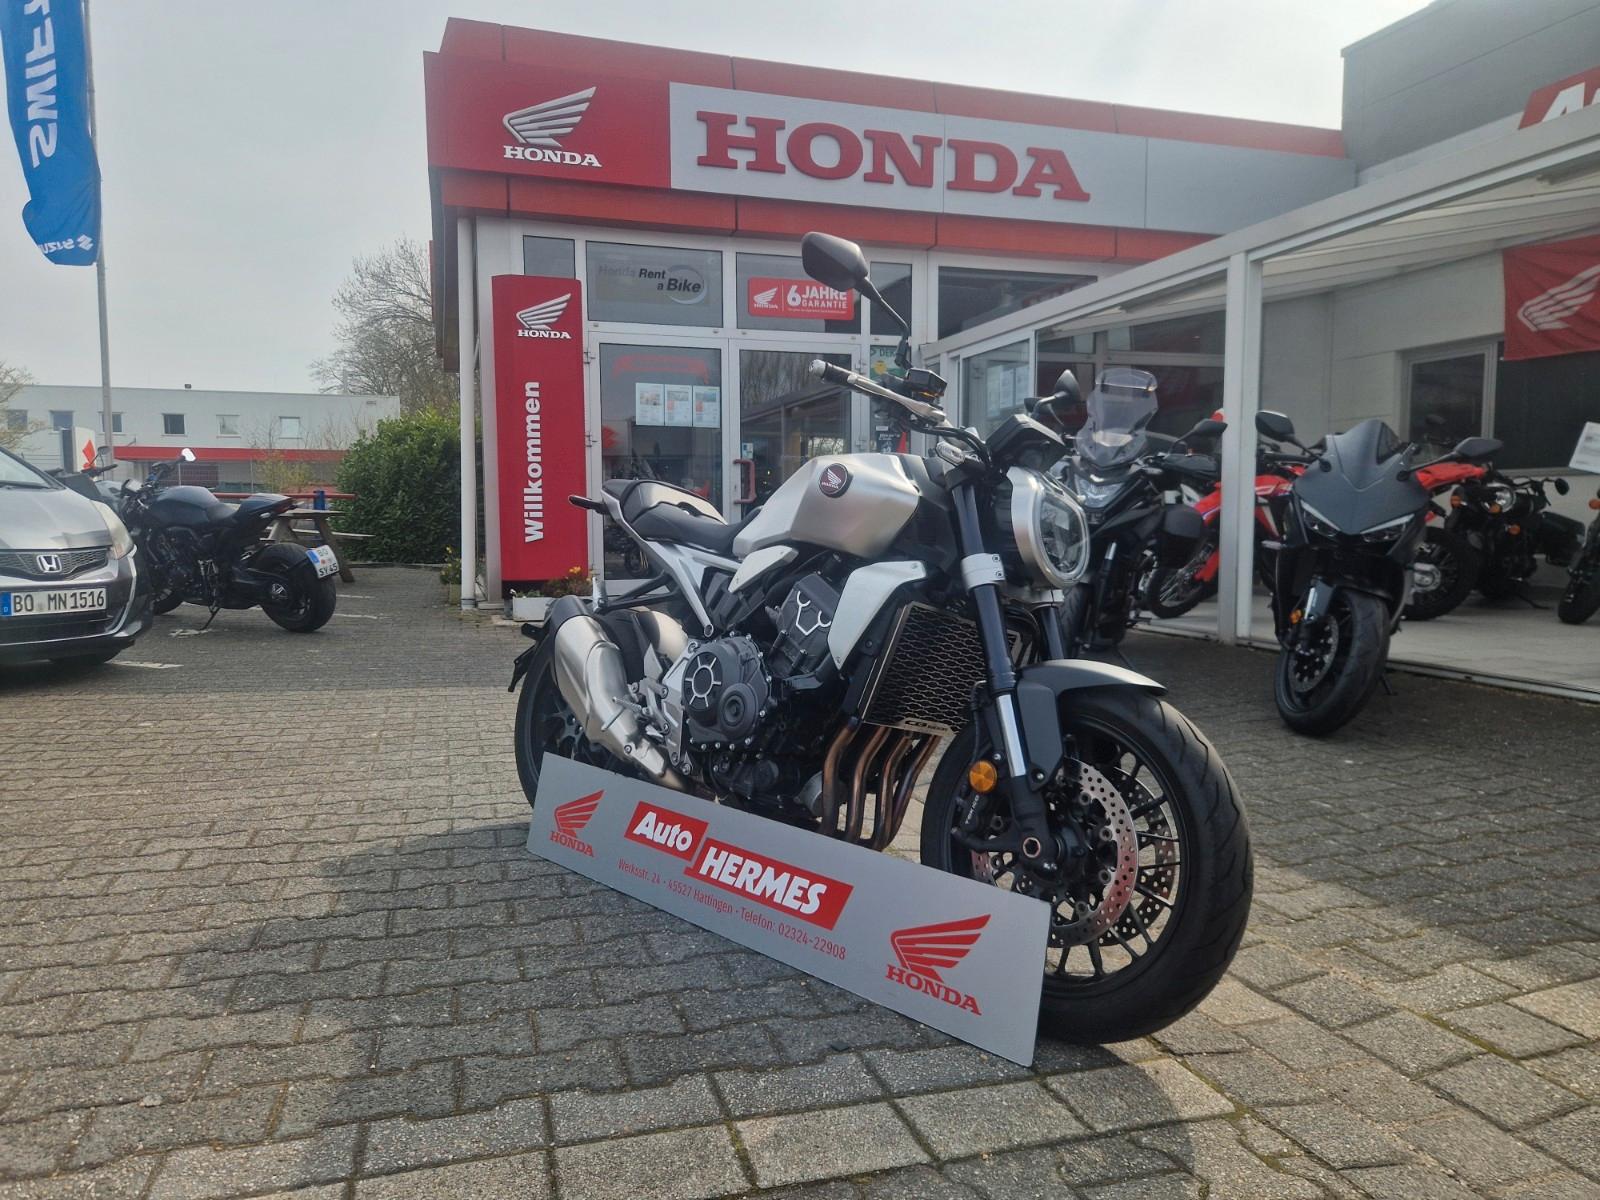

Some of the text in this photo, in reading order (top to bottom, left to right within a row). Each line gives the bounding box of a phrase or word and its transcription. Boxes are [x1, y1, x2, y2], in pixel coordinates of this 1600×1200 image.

[503, 145, 602, 167] HONDA
[697, 110, 1091, 202] HONDA
[639, 268, 666, 279] Rent
[666, 278, 702, 293] Bike
[787, 285, 848, 306] 6 JAHRE
[802, 300, 848, 309] GARANTIE
[517, 329, 572, 339] HONDA
[523, 382, 544, 543] Willkommen
[13, 590, 105, 612] BO MN 1516
[633, 811, 693, 851] Auto
[550, 830, 595, 857] HONDA
[699, 846, 827, 915] HERMES
[618, 858, 847, 961] Werksstr. 24 45527 Hattingen Telefon: 02324-22908
[885, 964, 982, 1016] HONDA
